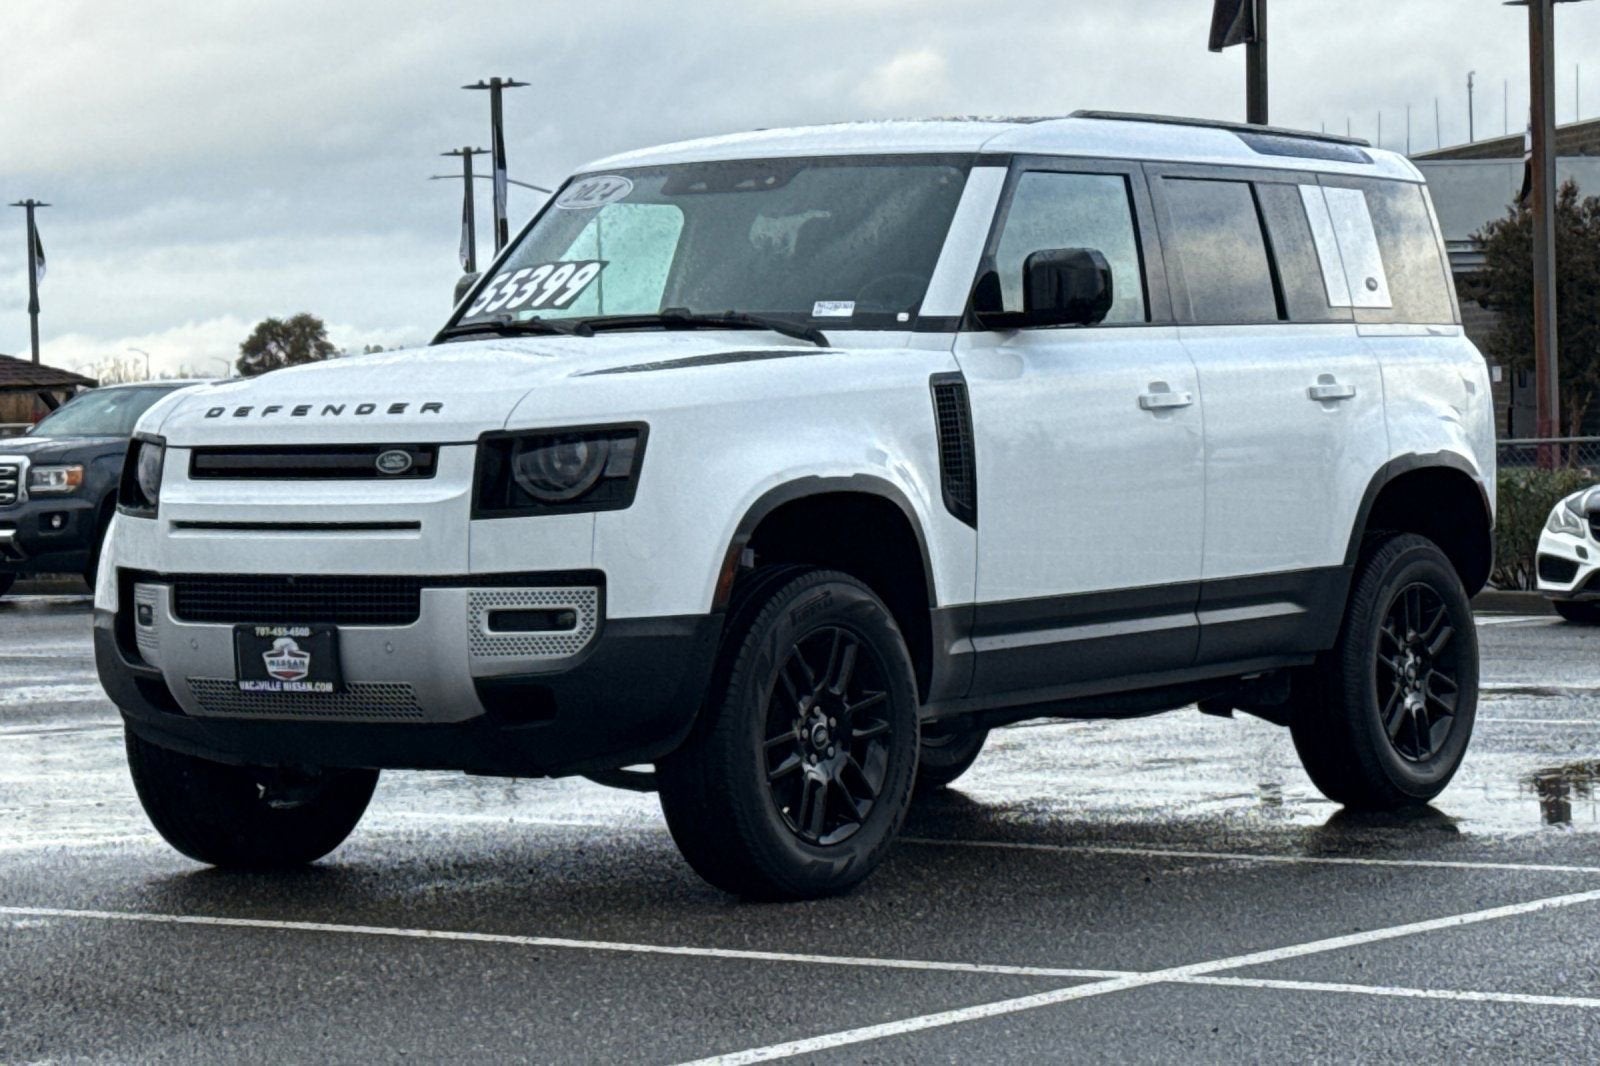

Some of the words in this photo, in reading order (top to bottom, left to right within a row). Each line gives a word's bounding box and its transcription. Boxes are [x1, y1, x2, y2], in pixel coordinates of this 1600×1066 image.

[466, 262, 601, 317] 55399
[204, 402, 444, 419] DEFENDER
[268, 658, 306, 668] NISSAN
